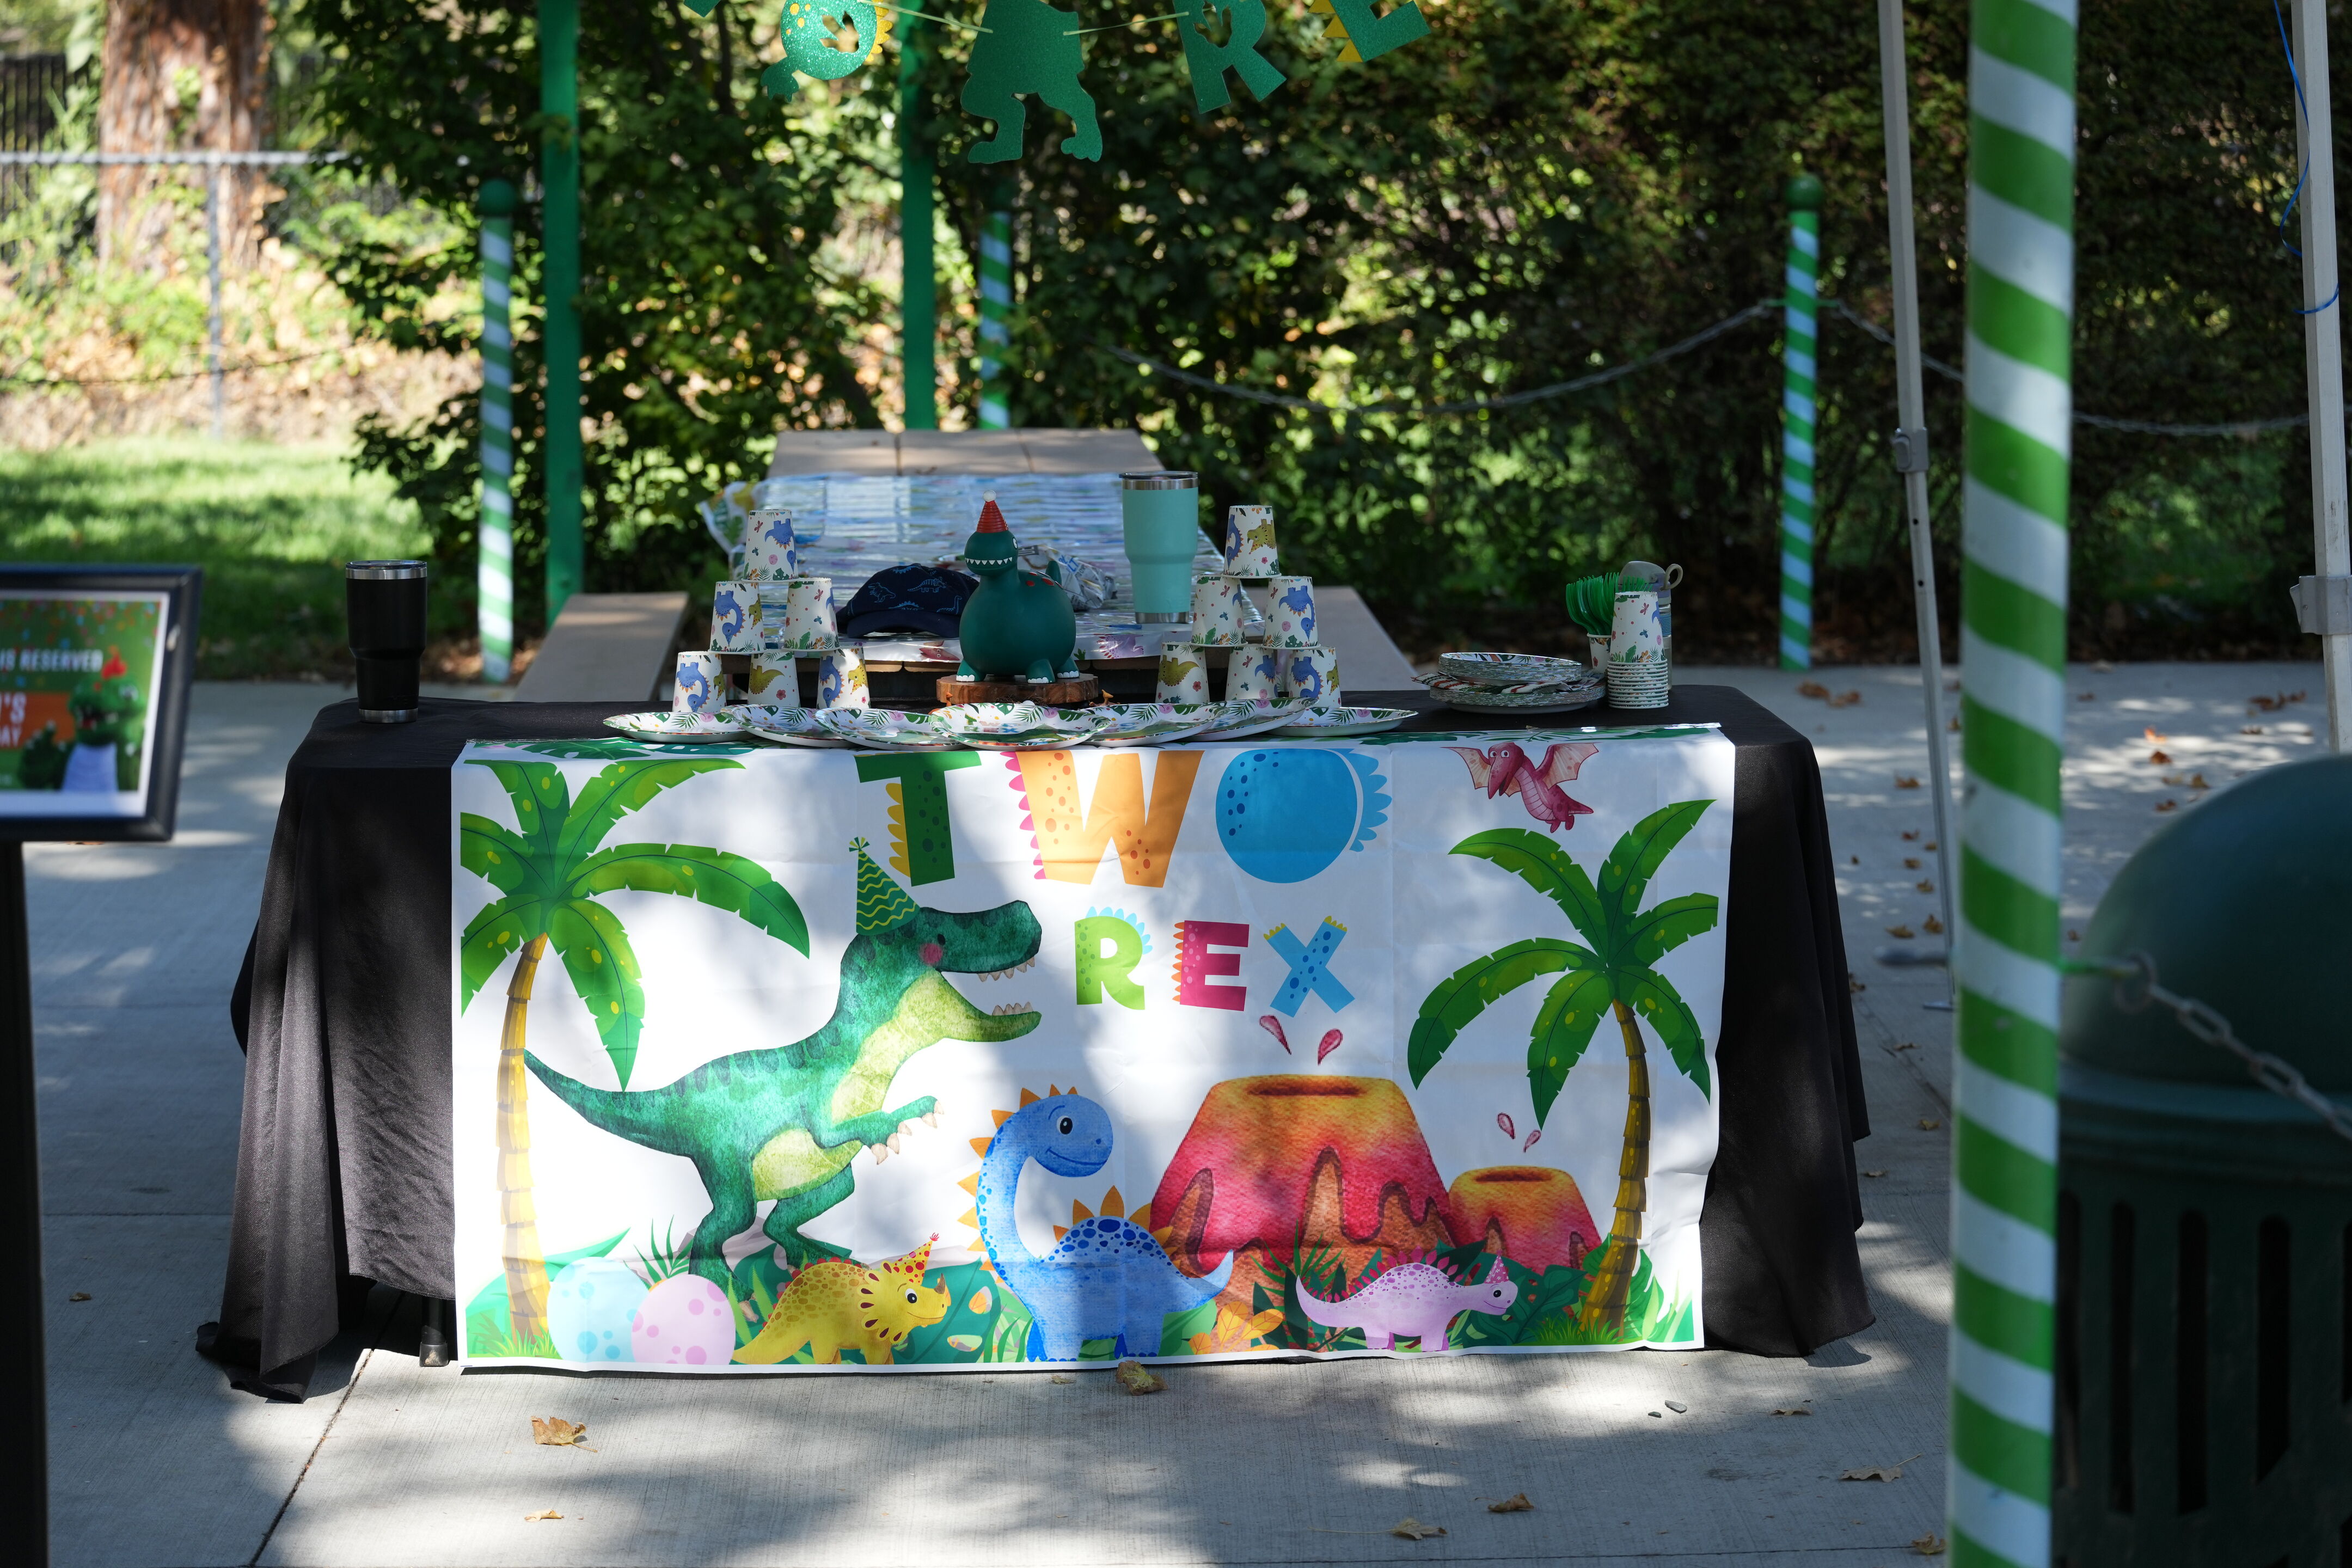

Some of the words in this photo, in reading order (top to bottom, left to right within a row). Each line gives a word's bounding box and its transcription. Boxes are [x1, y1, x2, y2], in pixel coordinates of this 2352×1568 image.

[20, 649, 103, 671] RESERVED
[854, 749, 1392, 888] TWO
[1074, 906, 1355, 1018] REX
